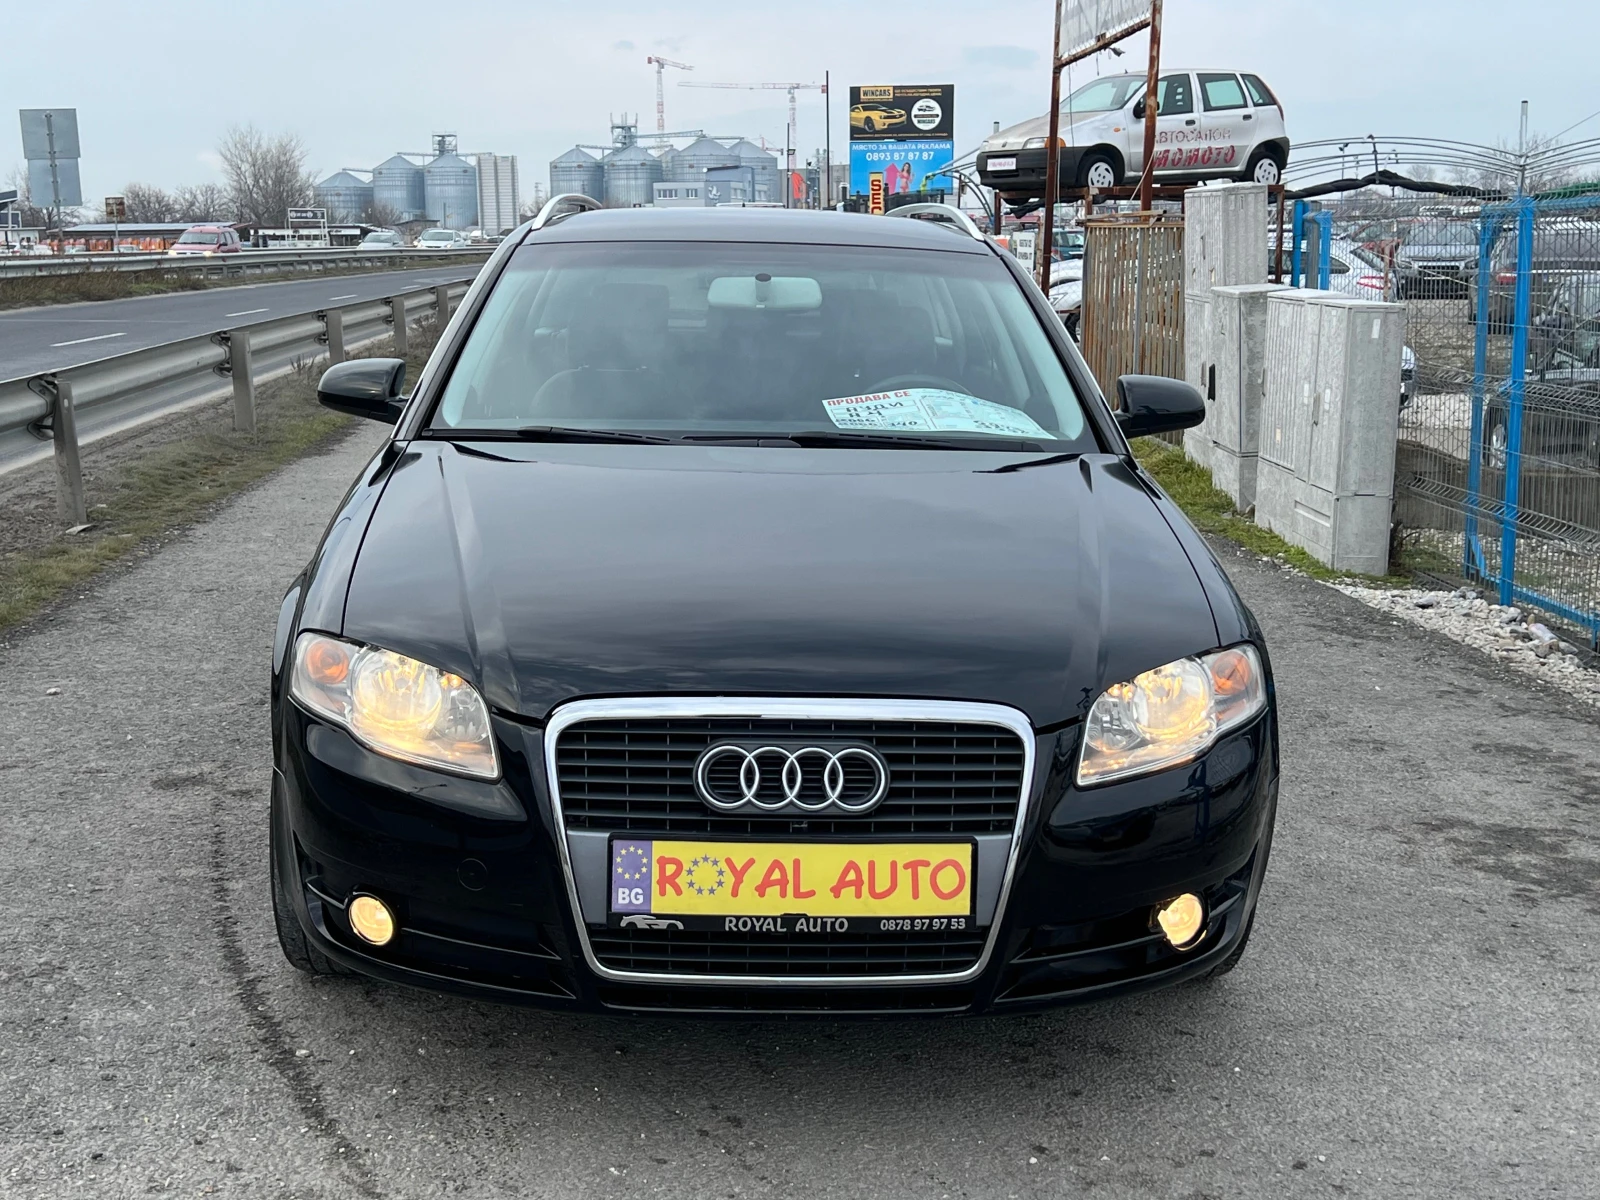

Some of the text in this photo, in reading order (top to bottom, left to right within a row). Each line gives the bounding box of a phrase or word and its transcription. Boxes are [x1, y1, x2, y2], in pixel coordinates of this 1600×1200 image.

[862, 89, 891, 97] WINCARS
[866, 151, 935, 161] 0893 87 87 87
[827, 393, 891, 406] ПРОДАВА
[656, 854, 966, 900] ROYAL AUTO
[617, 887, 644, 905] BG
[724, 917, 849, 932] ROYAL AUTO
[880, 918, 966, 930] 0878 97 97 53
